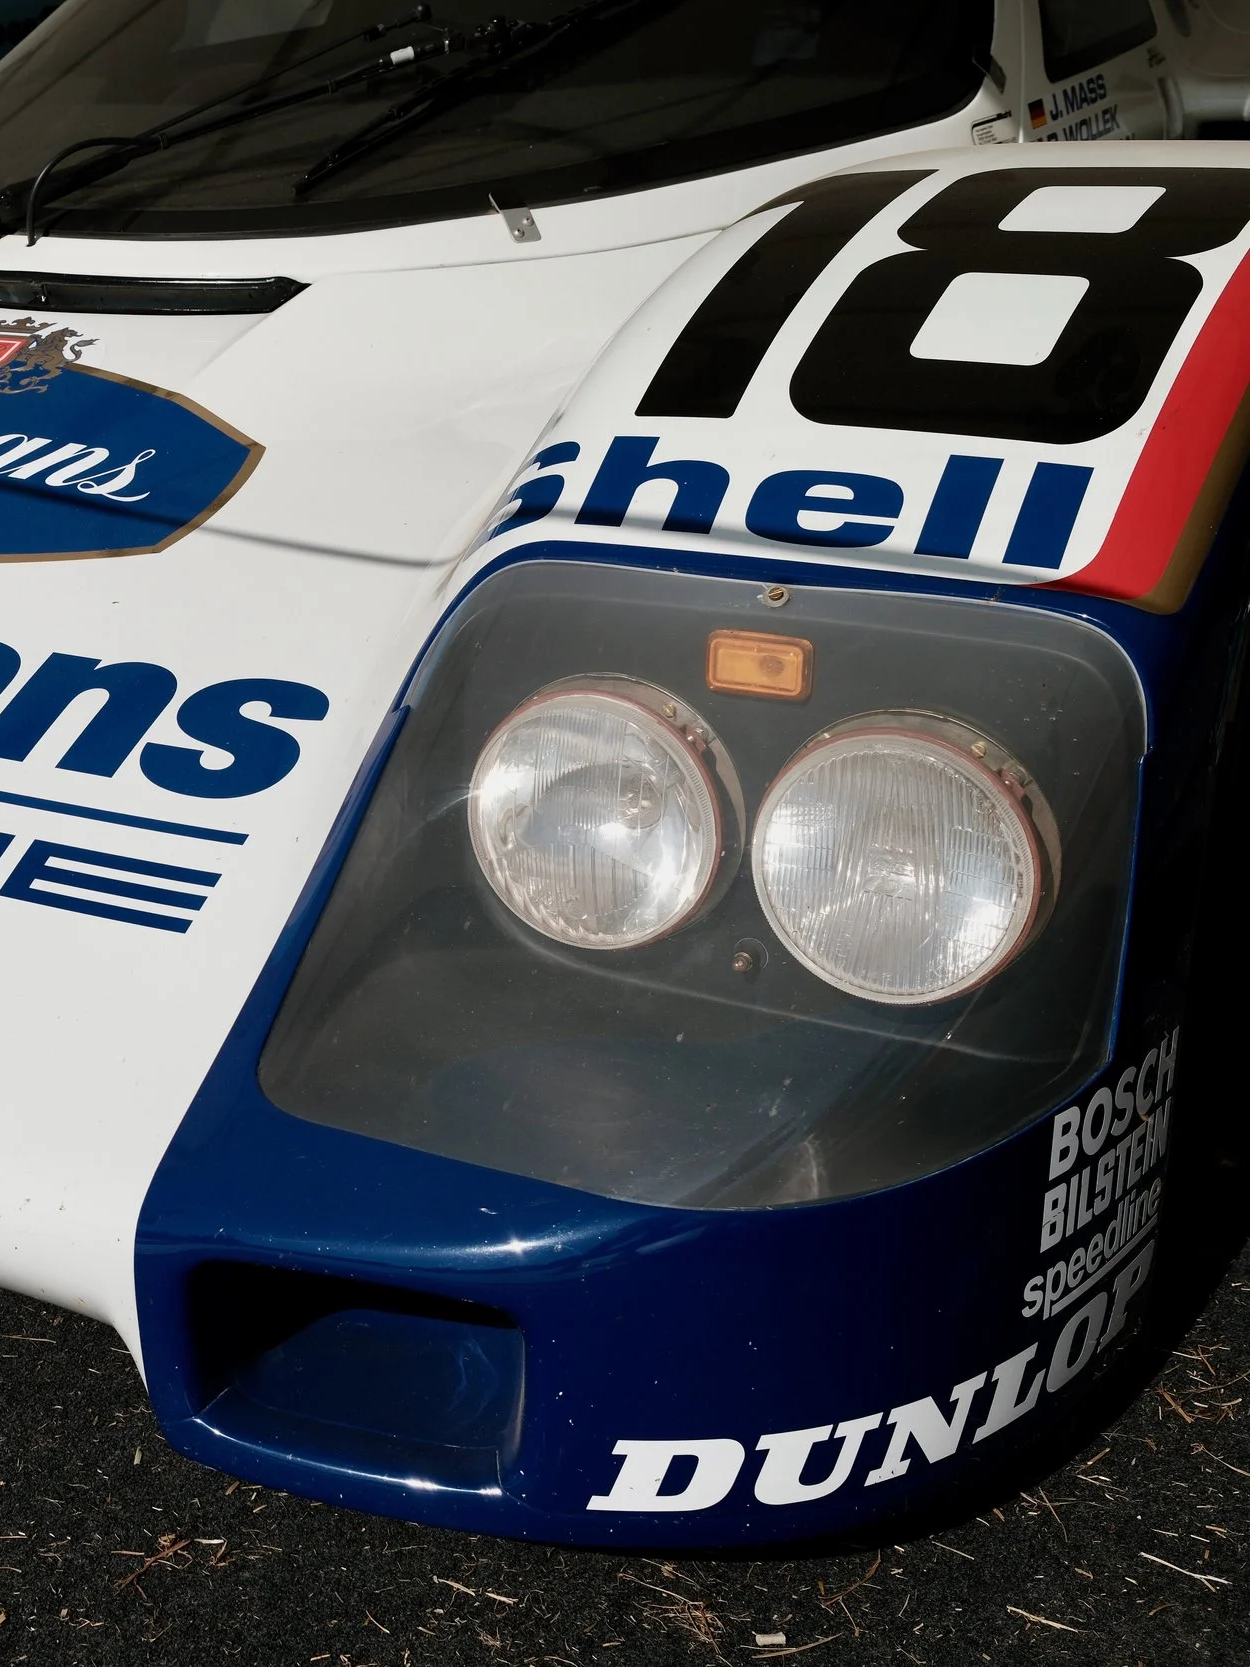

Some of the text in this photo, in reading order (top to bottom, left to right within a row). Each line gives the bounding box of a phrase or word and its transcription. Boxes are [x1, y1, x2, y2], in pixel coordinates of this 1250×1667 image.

[1062, 73, 1107, 115] MASS
[635, 167, 1250, 444] 18
[488, 436, 1094, 569] Shell
[1040, 1097, 1172, 1253] BILSTEIN
[1048, 1026, 1180, 1182] BOSCH
[1022, 1177, 1162, 1320] speedline
[586, 1239, 1156, 1511] DUNLOP
